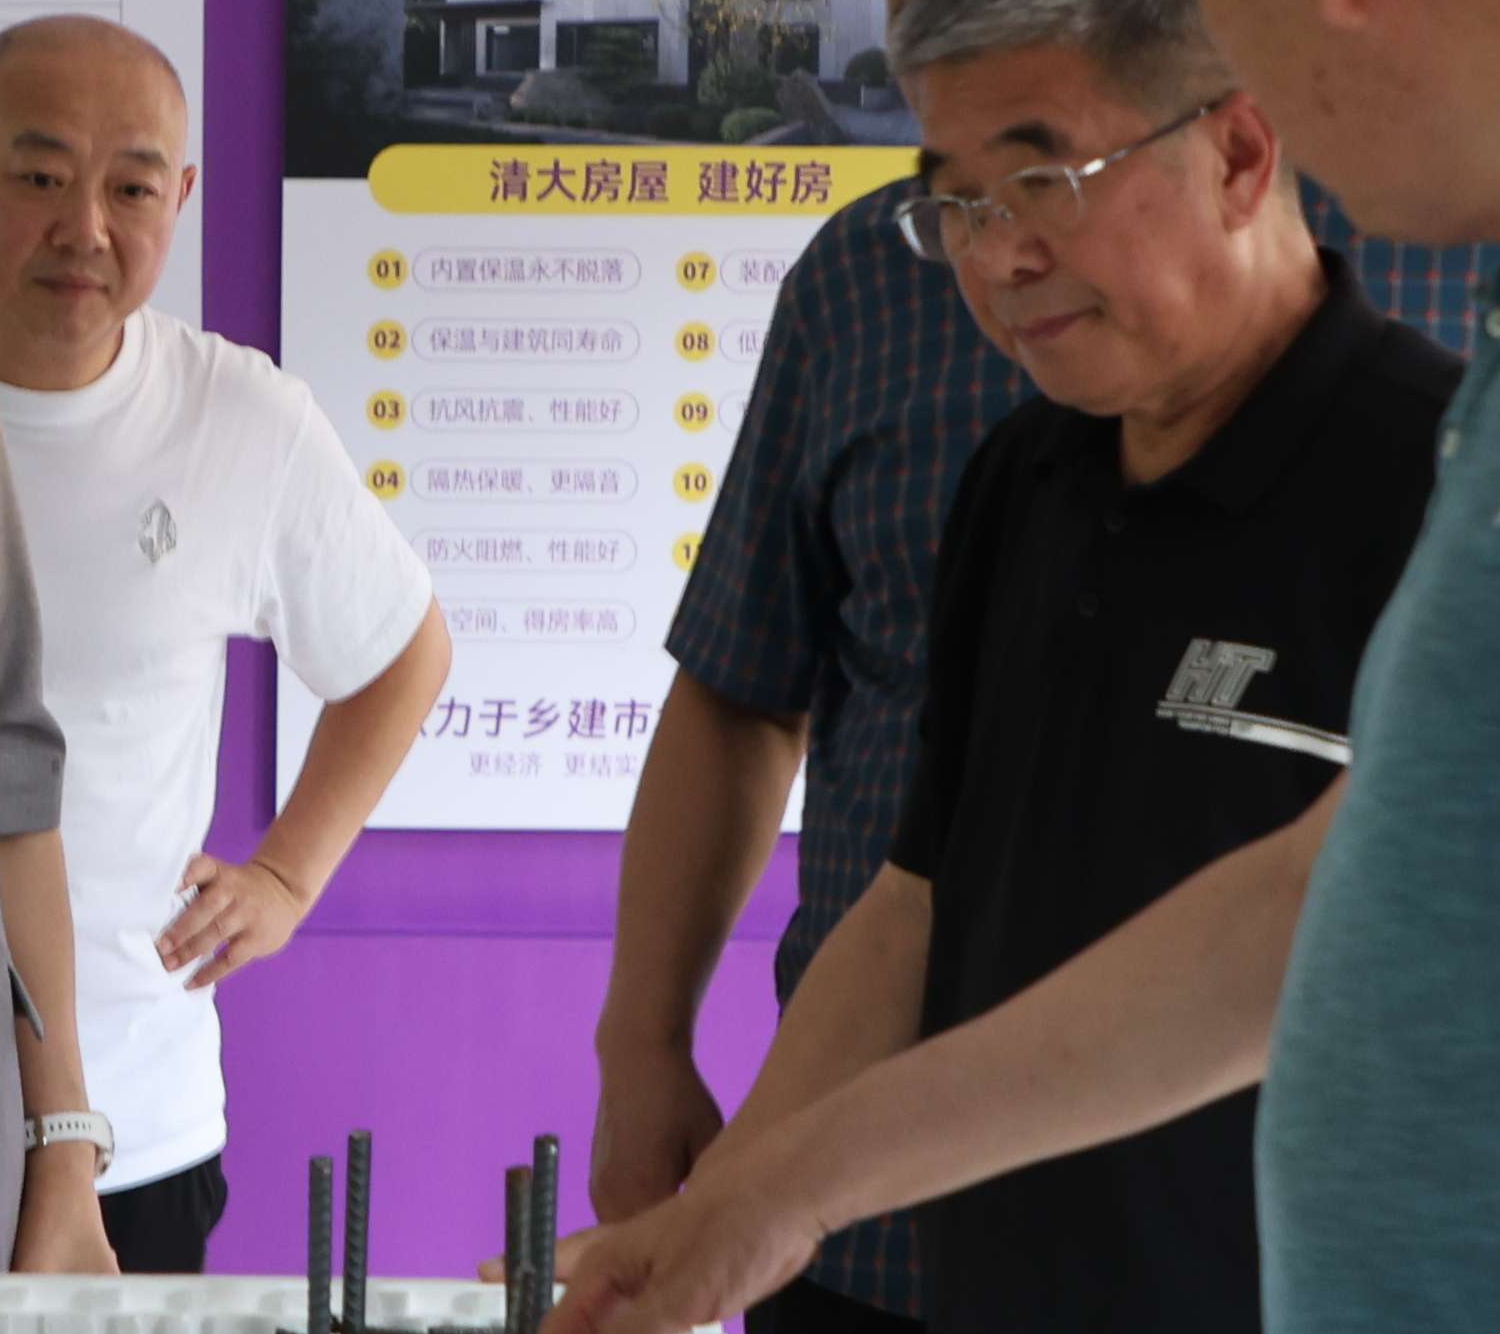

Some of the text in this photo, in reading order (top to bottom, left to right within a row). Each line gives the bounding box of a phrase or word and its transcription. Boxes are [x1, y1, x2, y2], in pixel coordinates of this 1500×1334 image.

[490, 158, 832, 204] 清大房屋 建好房
[376, 260, 402, 279] 01
[430, 259, 624, 284] 内置保温永不脱落
[683, 262, 710, 281] 07
[374, 331, 400, 350] 02
[429, 328, 623, 354] 保温与建筑同寿命
[682, 332, 709, 351] 08
[374, 400, 400, 419] 03
[428, 398, 622, 424] 抗风抗震、性能好
[681, 402, 708, 421] 09
[372, 470, 399, 489] 04
[427, 468, 621, 494] 隔热保暖、更隔音
[682, 473, 707, 491] 10
[426, 538, 619, 564] 防火阻燃、性能好
[442, 607, 619, 633] 空间、得房率高
[418, 696, 665, 740] 力于乡建市
[469, 752, 541, 777] 更经济
